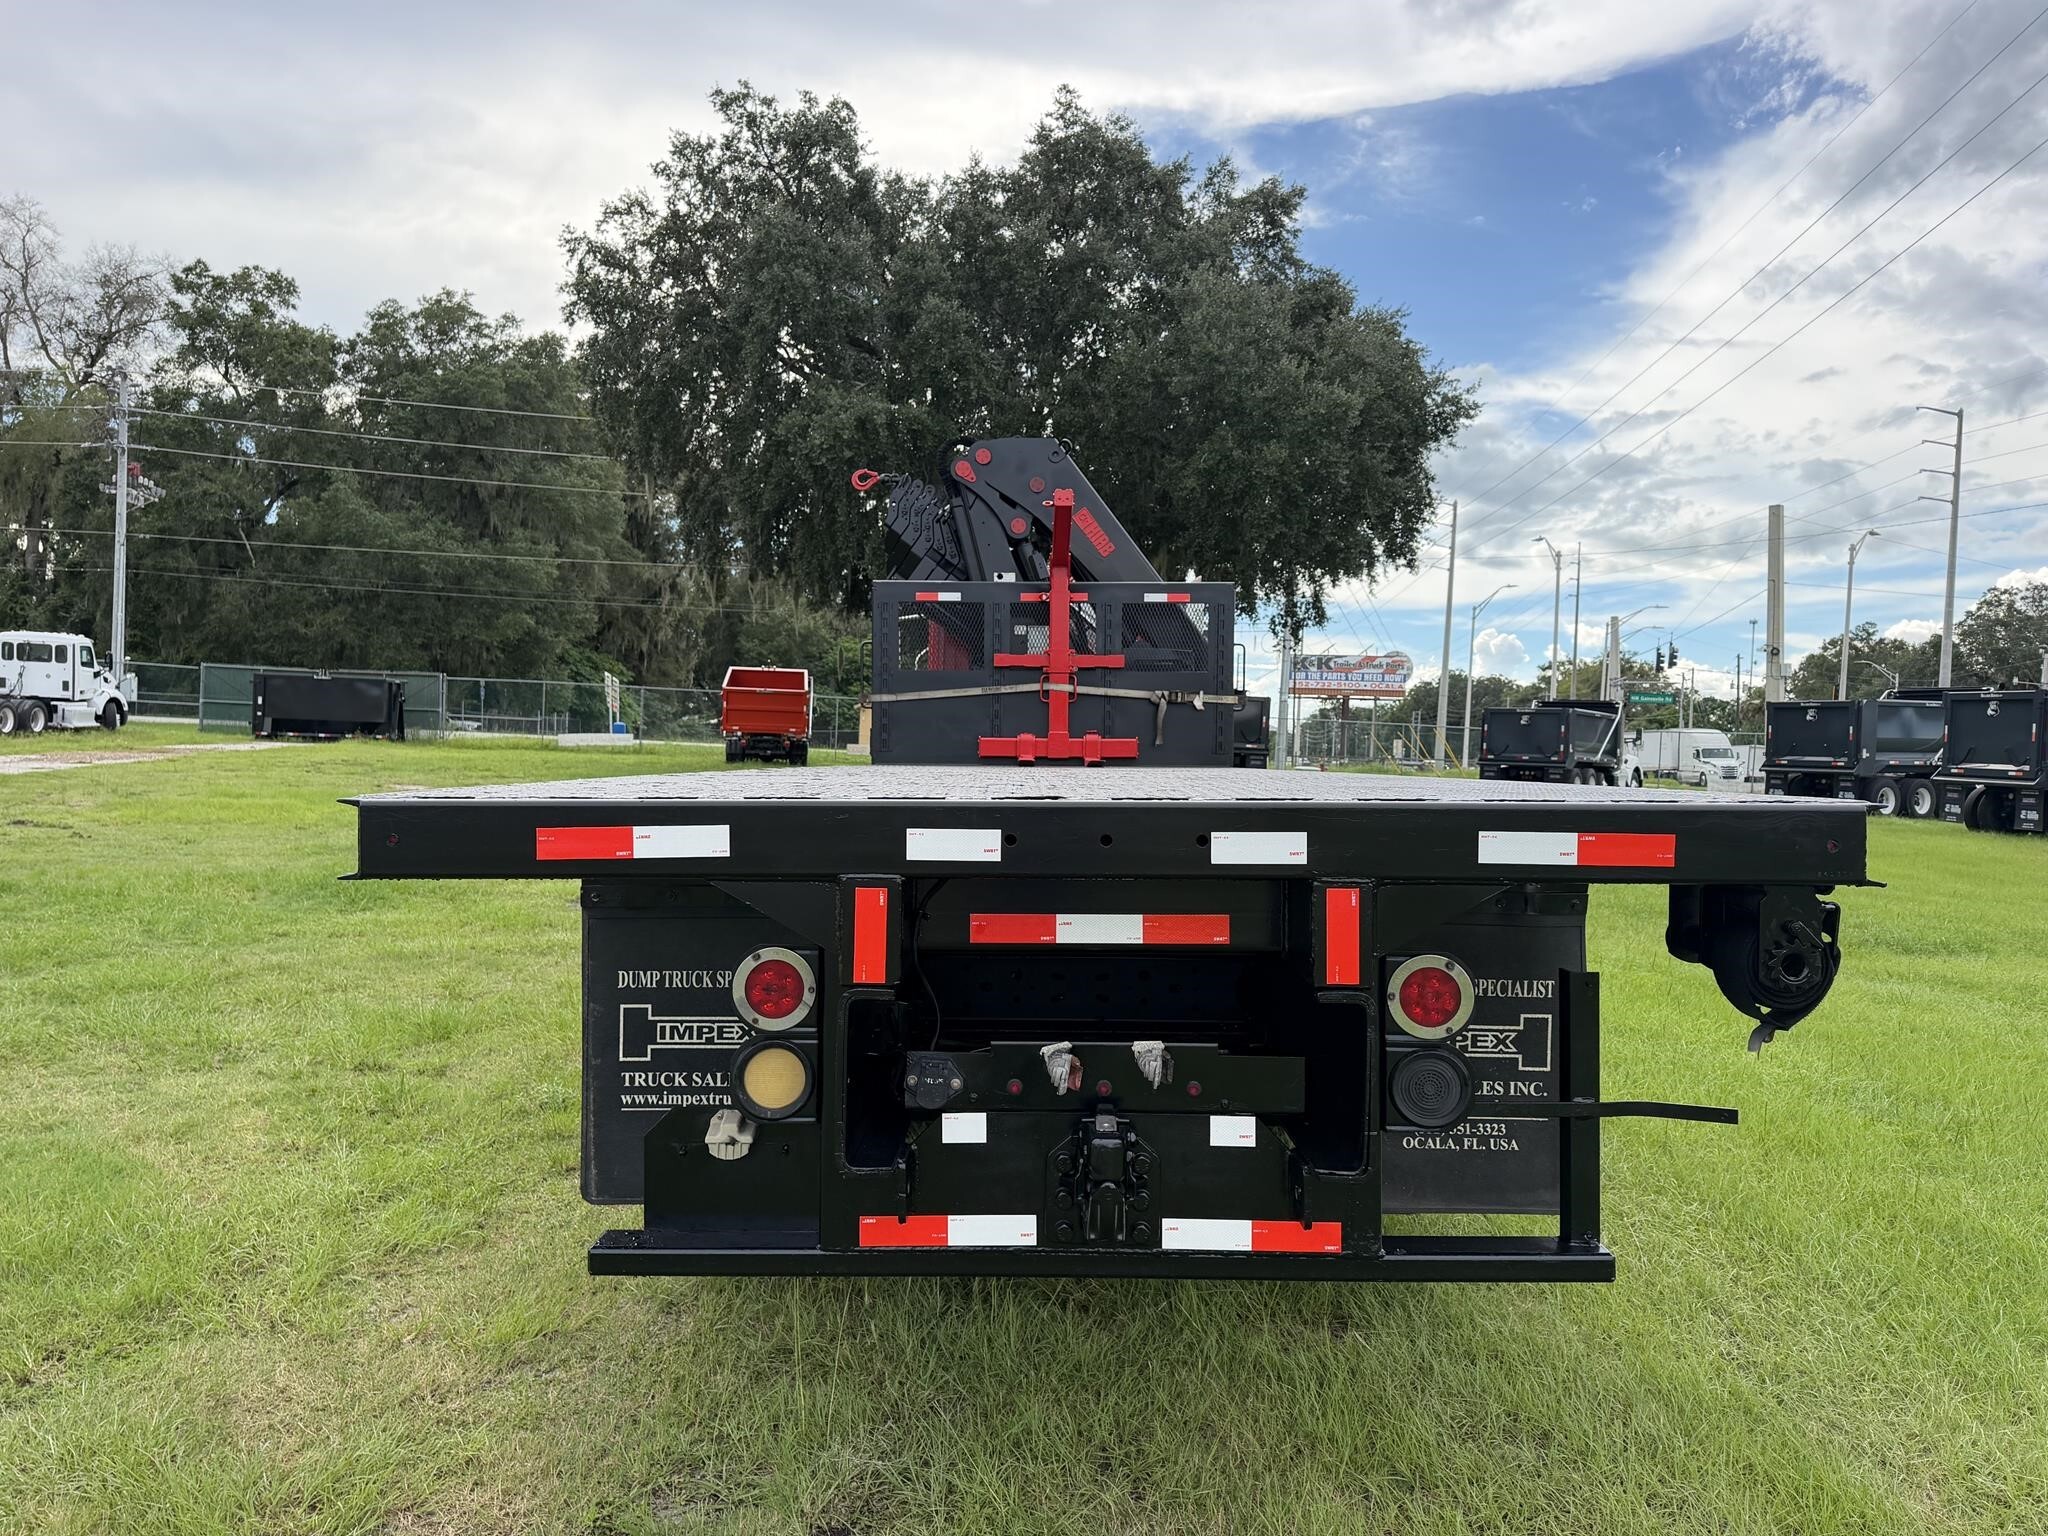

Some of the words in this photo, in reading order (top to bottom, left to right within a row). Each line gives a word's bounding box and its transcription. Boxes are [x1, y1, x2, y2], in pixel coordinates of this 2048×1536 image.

[1333, 660, 1355, 668] Trailer
[1366, 661, 1384, 669] Truck
[1307, 672, 1321, 680] THE
[1322, 672, 1346, 681] PARTS
[1347, 673, 1363, 681] YOU
[1364, 673, 1383, 682] NEED
[1384, 674, 1405, 682] NOW!
[1370, 682, 1405, 690] OCALA
[617, 970, 660, 989] DUMP
[663, 970, 713, 988] TRUCK
[716, 970, 732, 988] SP
[656, 1022, 757, 1043] IMPEX
[1455, 1031, 1519, 1052] PEX
[621, 1072, 688, 1087] TRUCK
[692, 1072, 731, 1087] SAL
[1475, 1081, 1504, 1096] ES
[1508, 1081, 1548, 1096] INC.
[620, 1091, 732, 1108] www.impextru
[1402, 1136, 1460, 1151] OCALA,
[1463, 1137, 1486, 1150] FL.
[1490, 1138, 1519, 1151] USA
